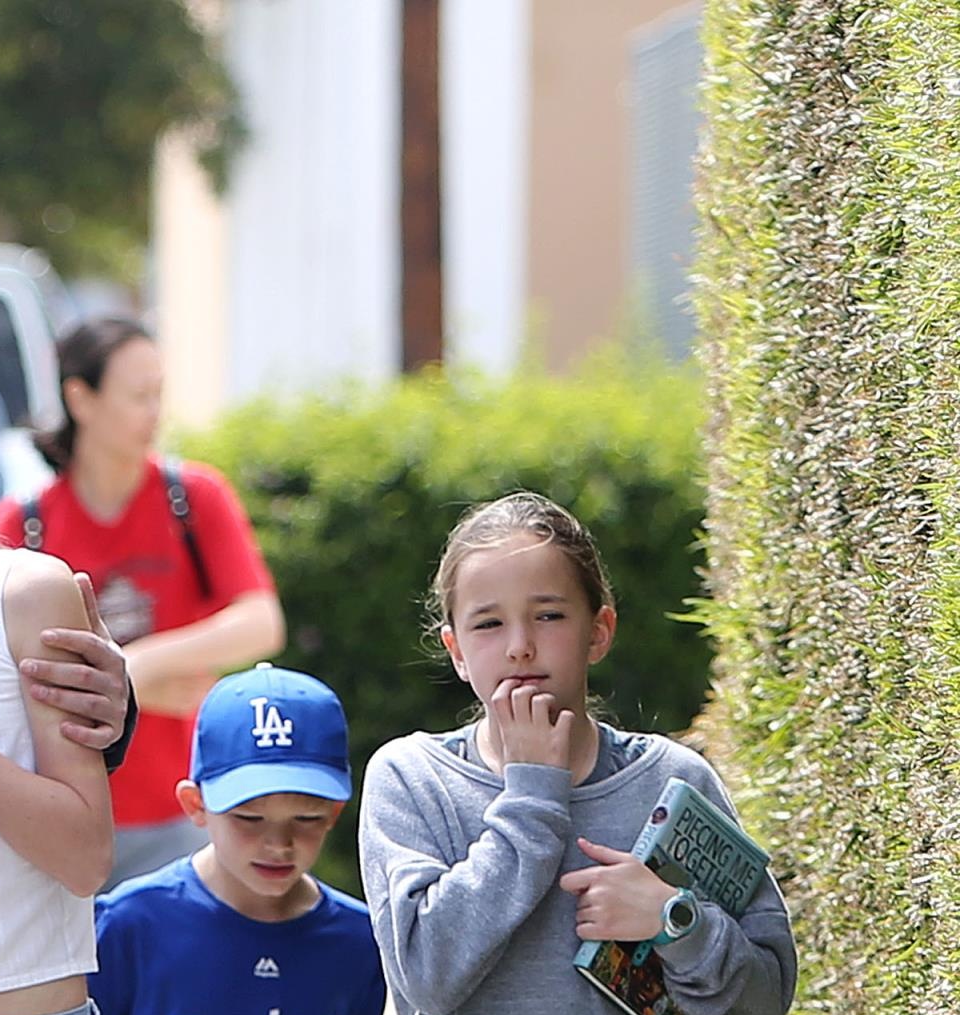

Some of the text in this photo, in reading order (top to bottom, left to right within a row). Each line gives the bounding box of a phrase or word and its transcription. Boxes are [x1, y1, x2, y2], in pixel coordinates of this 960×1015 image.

[250, 697, 293, 747] LA
[667, 828, 745, 911] TOGETHER
[676, 807, 758, 889] PIECING ME
